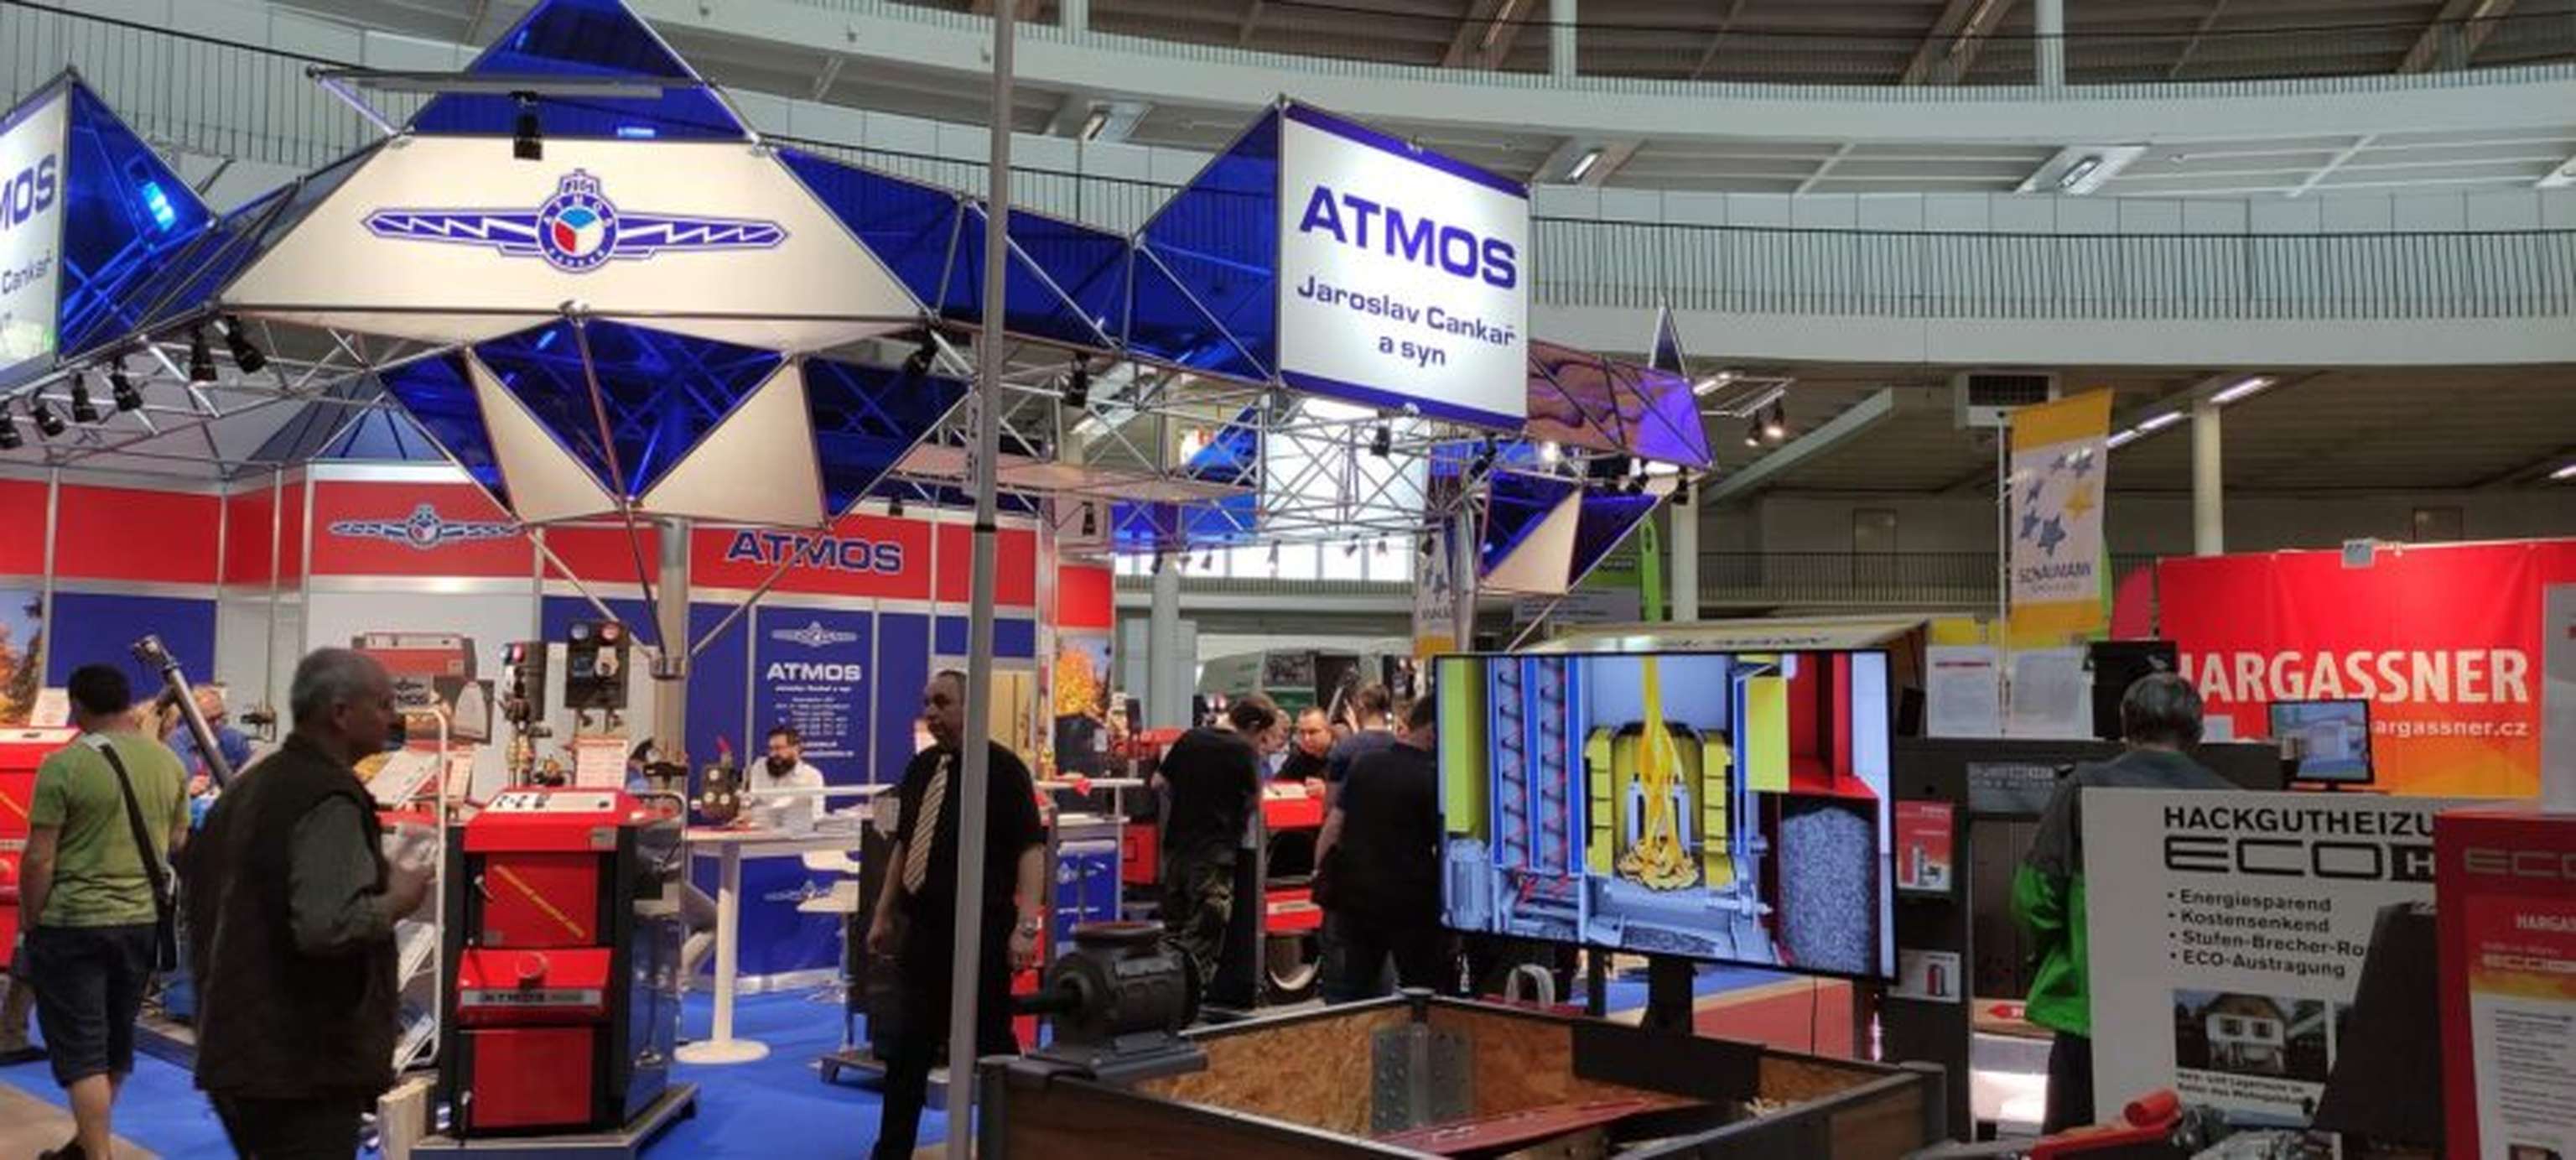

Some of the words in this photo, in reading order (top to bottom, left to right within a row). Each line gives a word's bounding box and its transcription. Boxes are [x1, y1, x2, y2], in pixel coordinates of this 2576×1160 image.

[1300, 185, 1516, 290] ATMOS
[1297, 275, 1420, 324] Jaroslav
[1426, 307, 1516, 346] Cankař
[1379, 336, 1394, 354] a
[1401, 341, 1446, 367] syn
[726, 529, 905, 575] ATMOS
[766, 662, 862, 681] ATMOS
[2374, 719, 2527, 736] argassner.cz
[2163, 806, 2435, 838] HACKGUTHEIZU
[2163, 835, 2436, 884] ECOH
[2180, 888, 2332, 913] Energiesparend
[2181, 910, 2330, 934] Kostensenkend
[2183, 929, 2365, 957] Stufen-Brecher-Ro
[2184, 949, 2346, 977] ECO-Austragung
